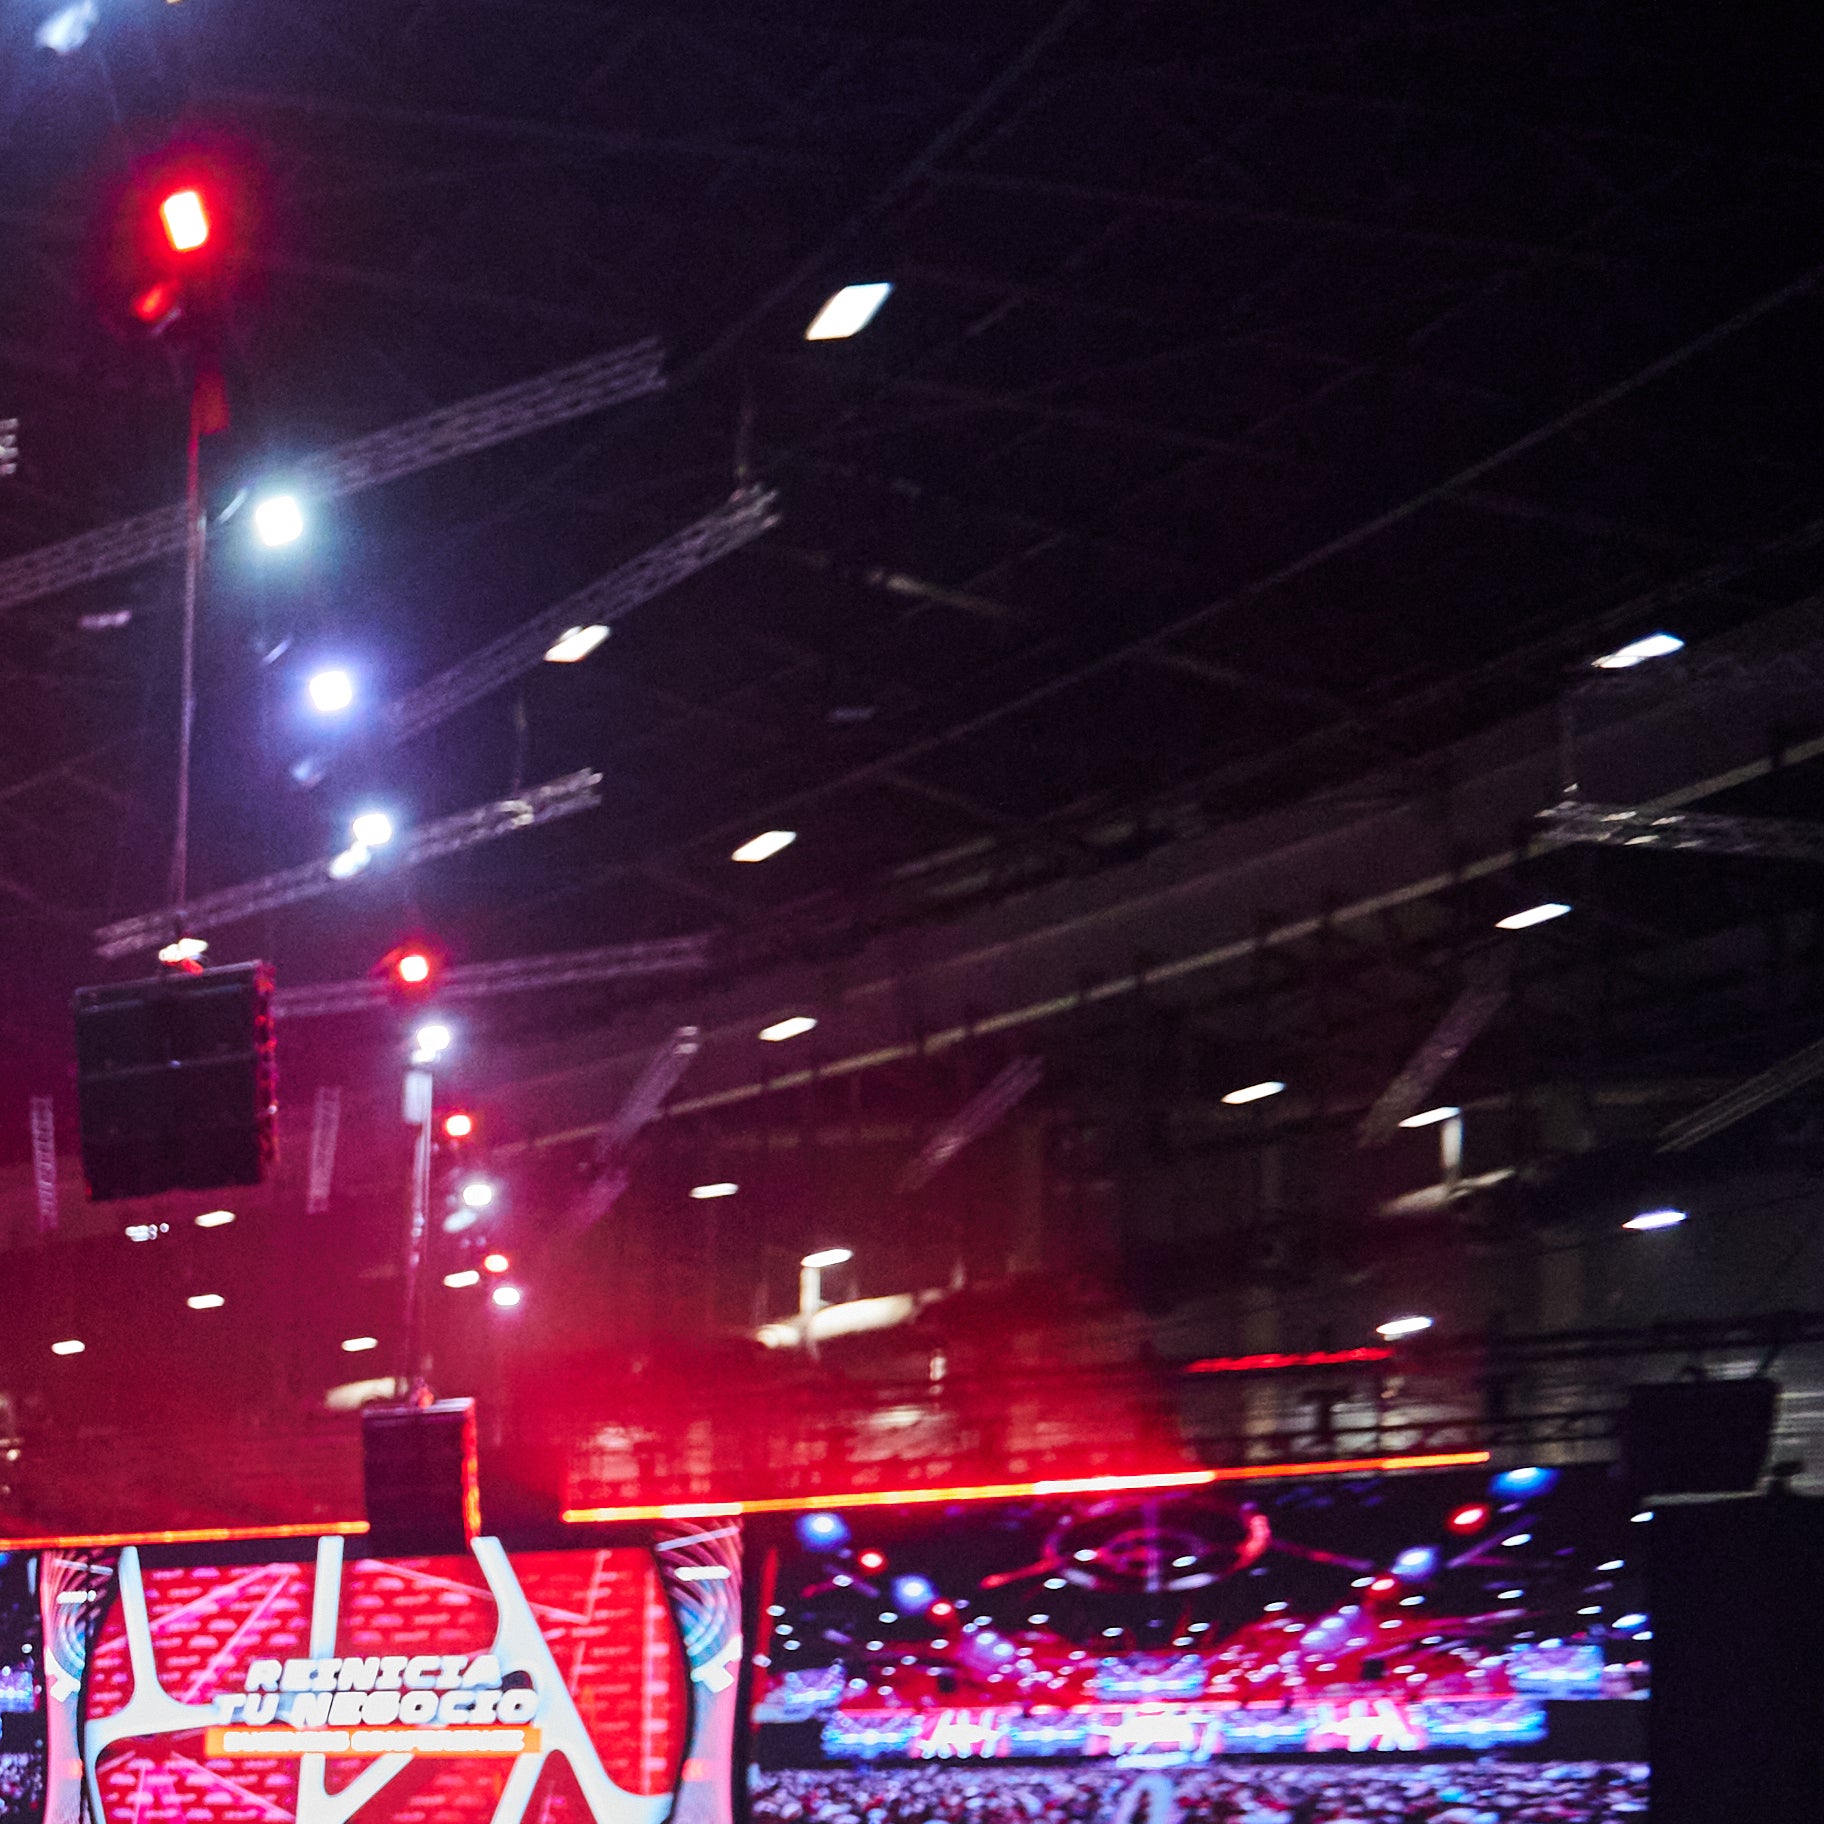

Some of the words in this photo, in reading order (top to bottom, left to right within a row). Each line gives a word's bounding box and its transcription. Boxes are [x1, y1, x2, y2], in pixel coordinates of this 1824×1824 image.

[245, 1655, 502, 1691] REINICIA
[214, 1693, 279, 1726] TU
[291, 1688, 539, 1727] NEGOCIO
